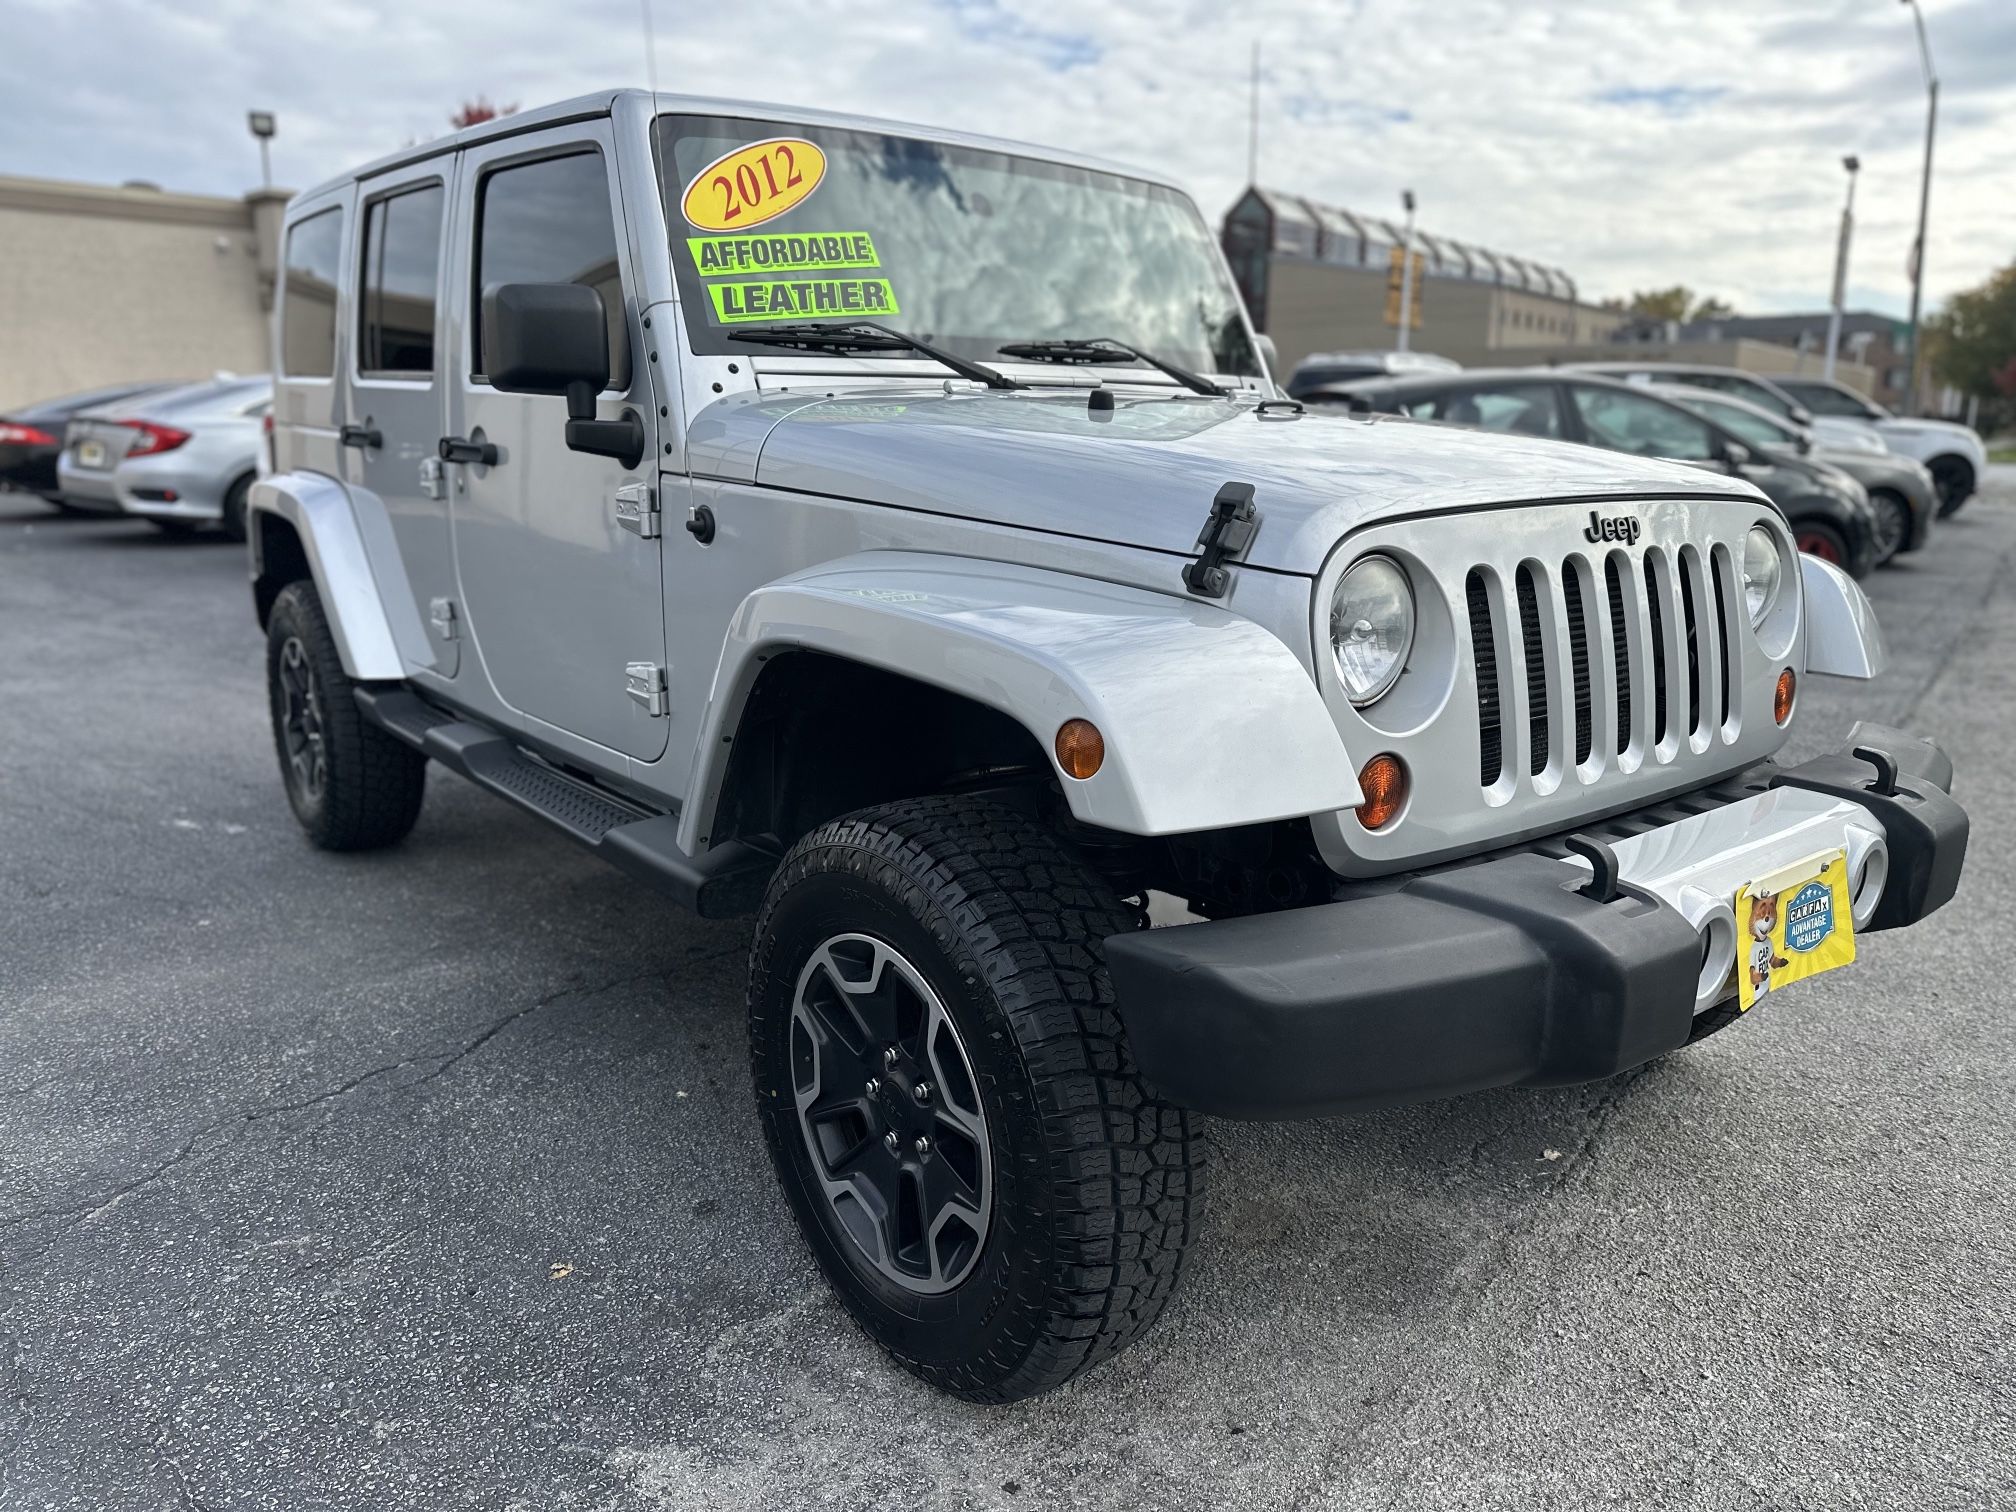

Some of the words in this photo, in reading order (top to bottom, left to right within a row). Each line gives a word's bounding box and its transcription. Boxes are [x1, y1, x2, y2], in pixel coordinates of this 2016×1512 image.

[713, 145, 802, 221] 2012
[701, 236, 874, 271] AFFORDABLE
[721, 281, 889, 317] LEATHER
[1583, 510, 1641, 546] Jeep
[1790, 897, 1828, 923] CARFAX
[1791, 914, 1827, 936] ADVANTAGE
[1796, 929, 1821, 947] DEALER
